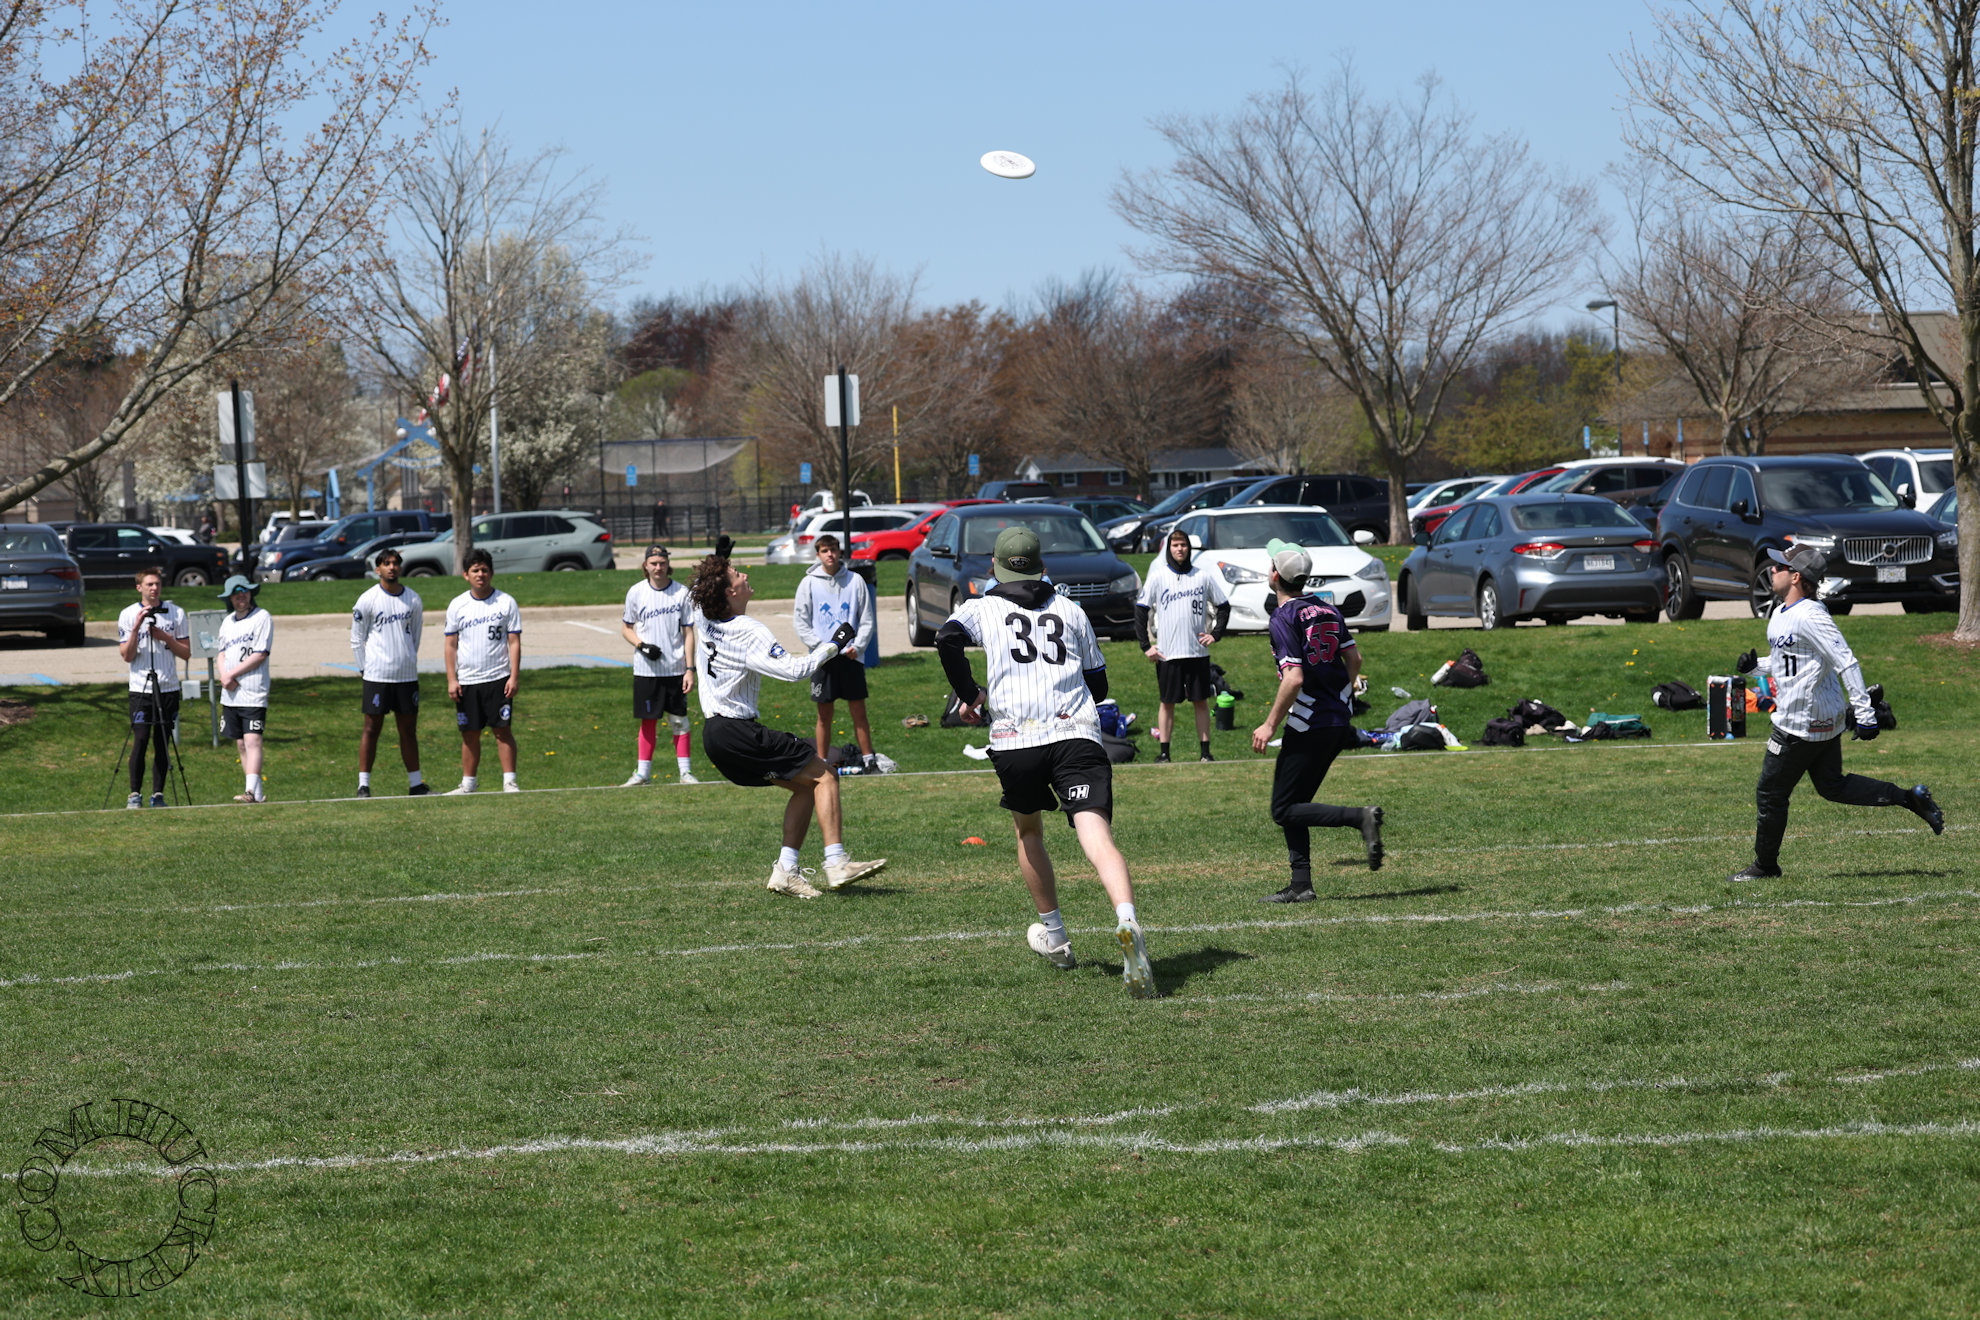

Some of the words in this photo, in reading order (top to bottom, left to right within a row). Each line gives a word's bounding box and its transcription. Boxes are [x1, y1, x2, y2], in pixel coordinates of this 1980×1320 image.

[1161, 585, 1205, 611] Gnomes
[1191, 599, 1204, 616] 99
[640, 602, 681, 627] Gnomes
[488, 626, 502, 640] 55
[837, 630, 846, 640] 2
[1005, 612, 1066, 665] 33
[1305, 621, 1340, 666] 55
[705, 641, 718, 679] 2
[1783, 655, 1797, 676] 11
[373, 694, 380, 707] 4
[644, 699, 652, 713] 1
